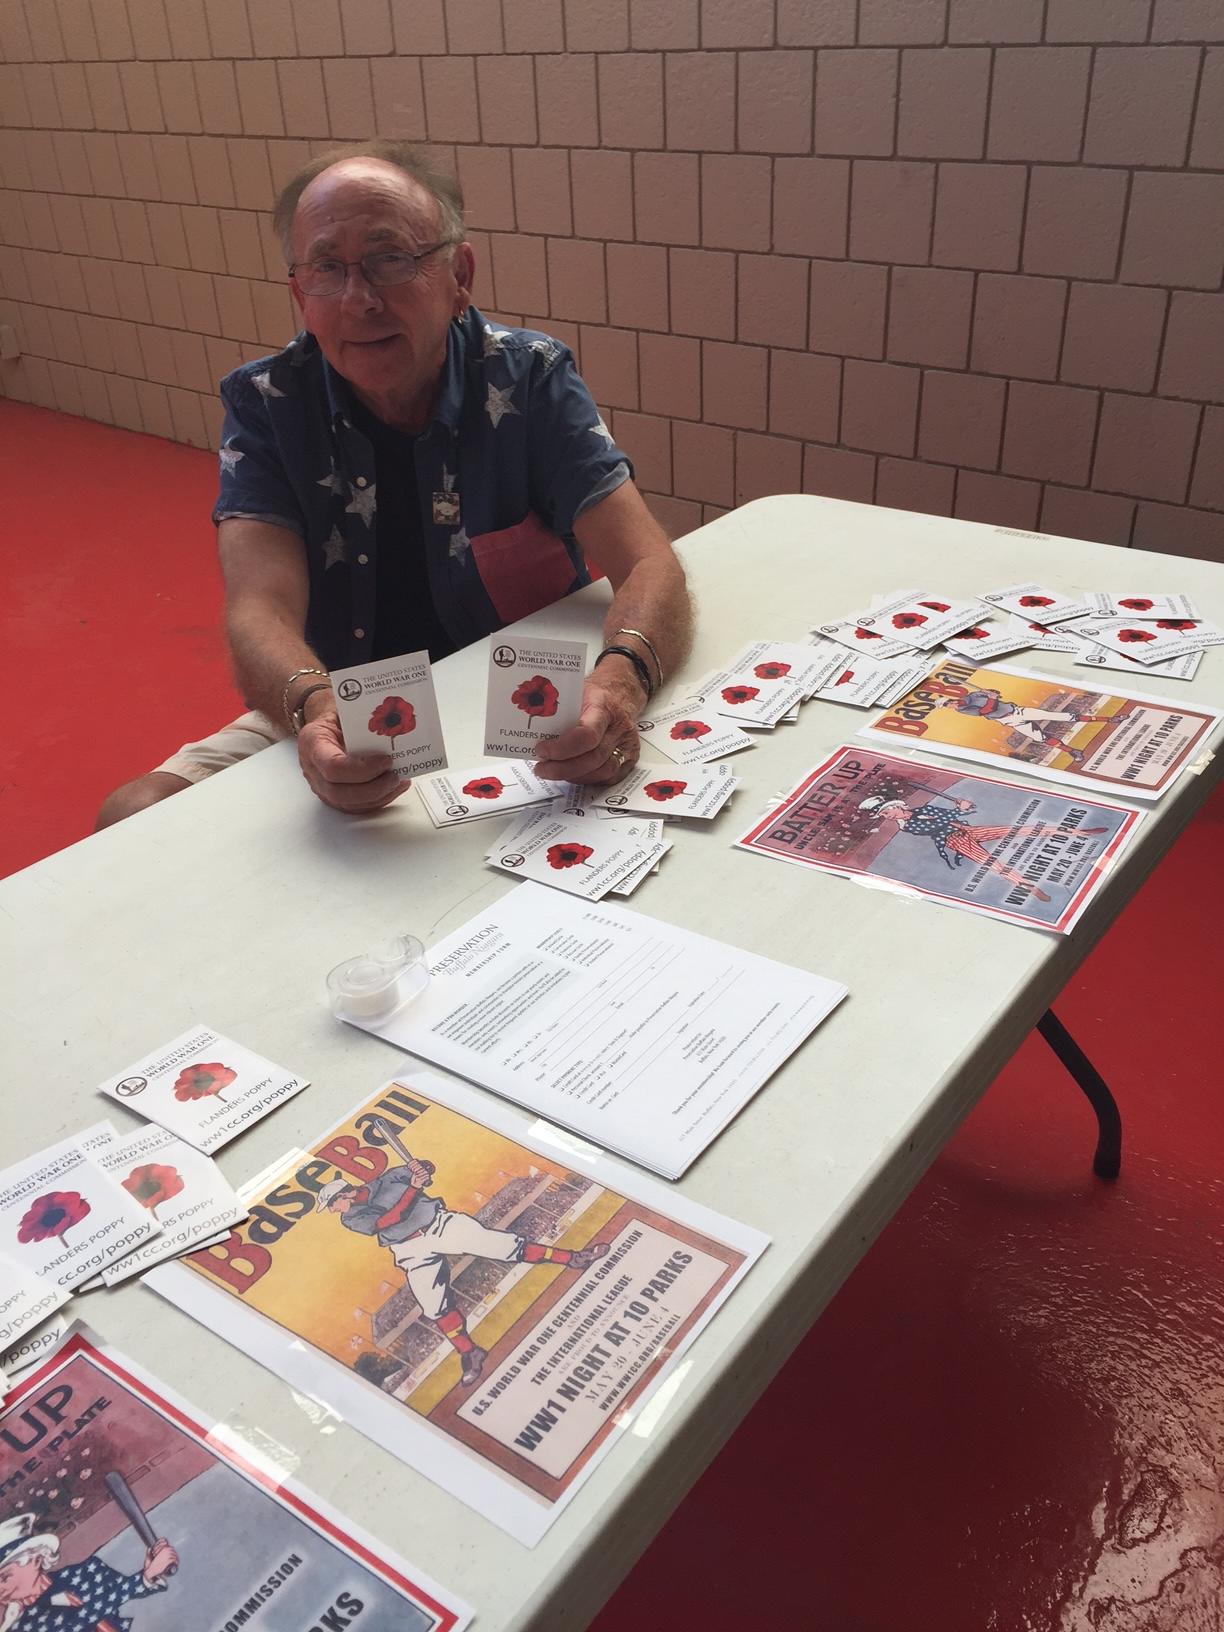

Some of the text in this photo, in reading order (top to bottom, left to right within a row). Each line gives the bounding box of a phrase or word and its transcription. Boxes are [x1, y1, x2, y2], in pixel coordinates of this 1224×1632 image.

[518, 655, 581, 668] WORLD WAR ONE
[533, 650, 558, 659] UNITED
[559, 653, 582, 661] STATES
[363, 670, 427, 689] WORLD WAR ONE
[500, 728, 539, 739] FLANDERS
[1159, 714, 1184, 735] PARKS
[406, 743, 432, 756] POPPY
[486, 742, 537, 756] ww1cc.org
[1136, 742, 1159, 765] NIGHT
[1147, 738, 1163, 748] AT
[392, 756, 444, 776] org/poppy
[1120, 763, 1144, 780] WW1
[768, 760, 865, 845] BATTER UP
[1016, 798, 1042, 827] COMMISSION
[993, 847, 1003, 858] ONE
[997, 824, 1021, 851] CENTENNIAL
[1007, 837, 1035, 868] INTERNATIONAL
[586, 849, 647, 898] ww1cc.org/poppy
[1004, 807, 1088, 906] WW1 NIGHT AT 10 PARKS
[1047, 866, 1065, 884] MAY
[1061, 857, 1072, 868] 20
[1069, 841, 1087, 858] JUNE
[971, 865, 990, 885] WORLD
[429, 923, 499, 977] PRESERVATION
[145, 1033, 216, 1078] WORLD WAR ONE
[198, 1076, 274, 1129] FLANDERS POPPY
[199, 1078, 299, 1148] ww1cc.org/poppy
[138, 1137, 162, 1153] WAR
[12, 1149, 80, 1191] UNITED STATES
[36, 1167, 61, 1184] WAR
[60, 1152, 85, 1170] ONE
[177, 1198, 215, 1221] POPPY
[187, 1089, 431, 1295] BaseBall
[35, 1216, 126, 1276] LANDERS POPPY
[57, 1222, 151, 1286] cc.org/poppy
[105, 1207, 238, 1276] ww1cc.org/poppy
[0, 1289, 27, 1314] OPPY
[0, 1291, 58, 1340] g/poppy
[471, 1229, 644, 1417] U.S. WORLD WAR ONE CENTENNIAL COMMISSION
[530, 1273, 633, 1387] THE INTERNATIONAL LEAGUE
[2, 1328, 61, 1369] /poppy
[513, 1249, 693, 1452] WW1 NIGHT AT 10 PARKS
[598, 1313, 681, 1412] WWW.WW1CC.ORG/BASEBALL
[585, 1371, 614, 1403] MAY
[0, 1384, 73, 1453] UP
[218, 1553, 303, 1632] OMMISSION
